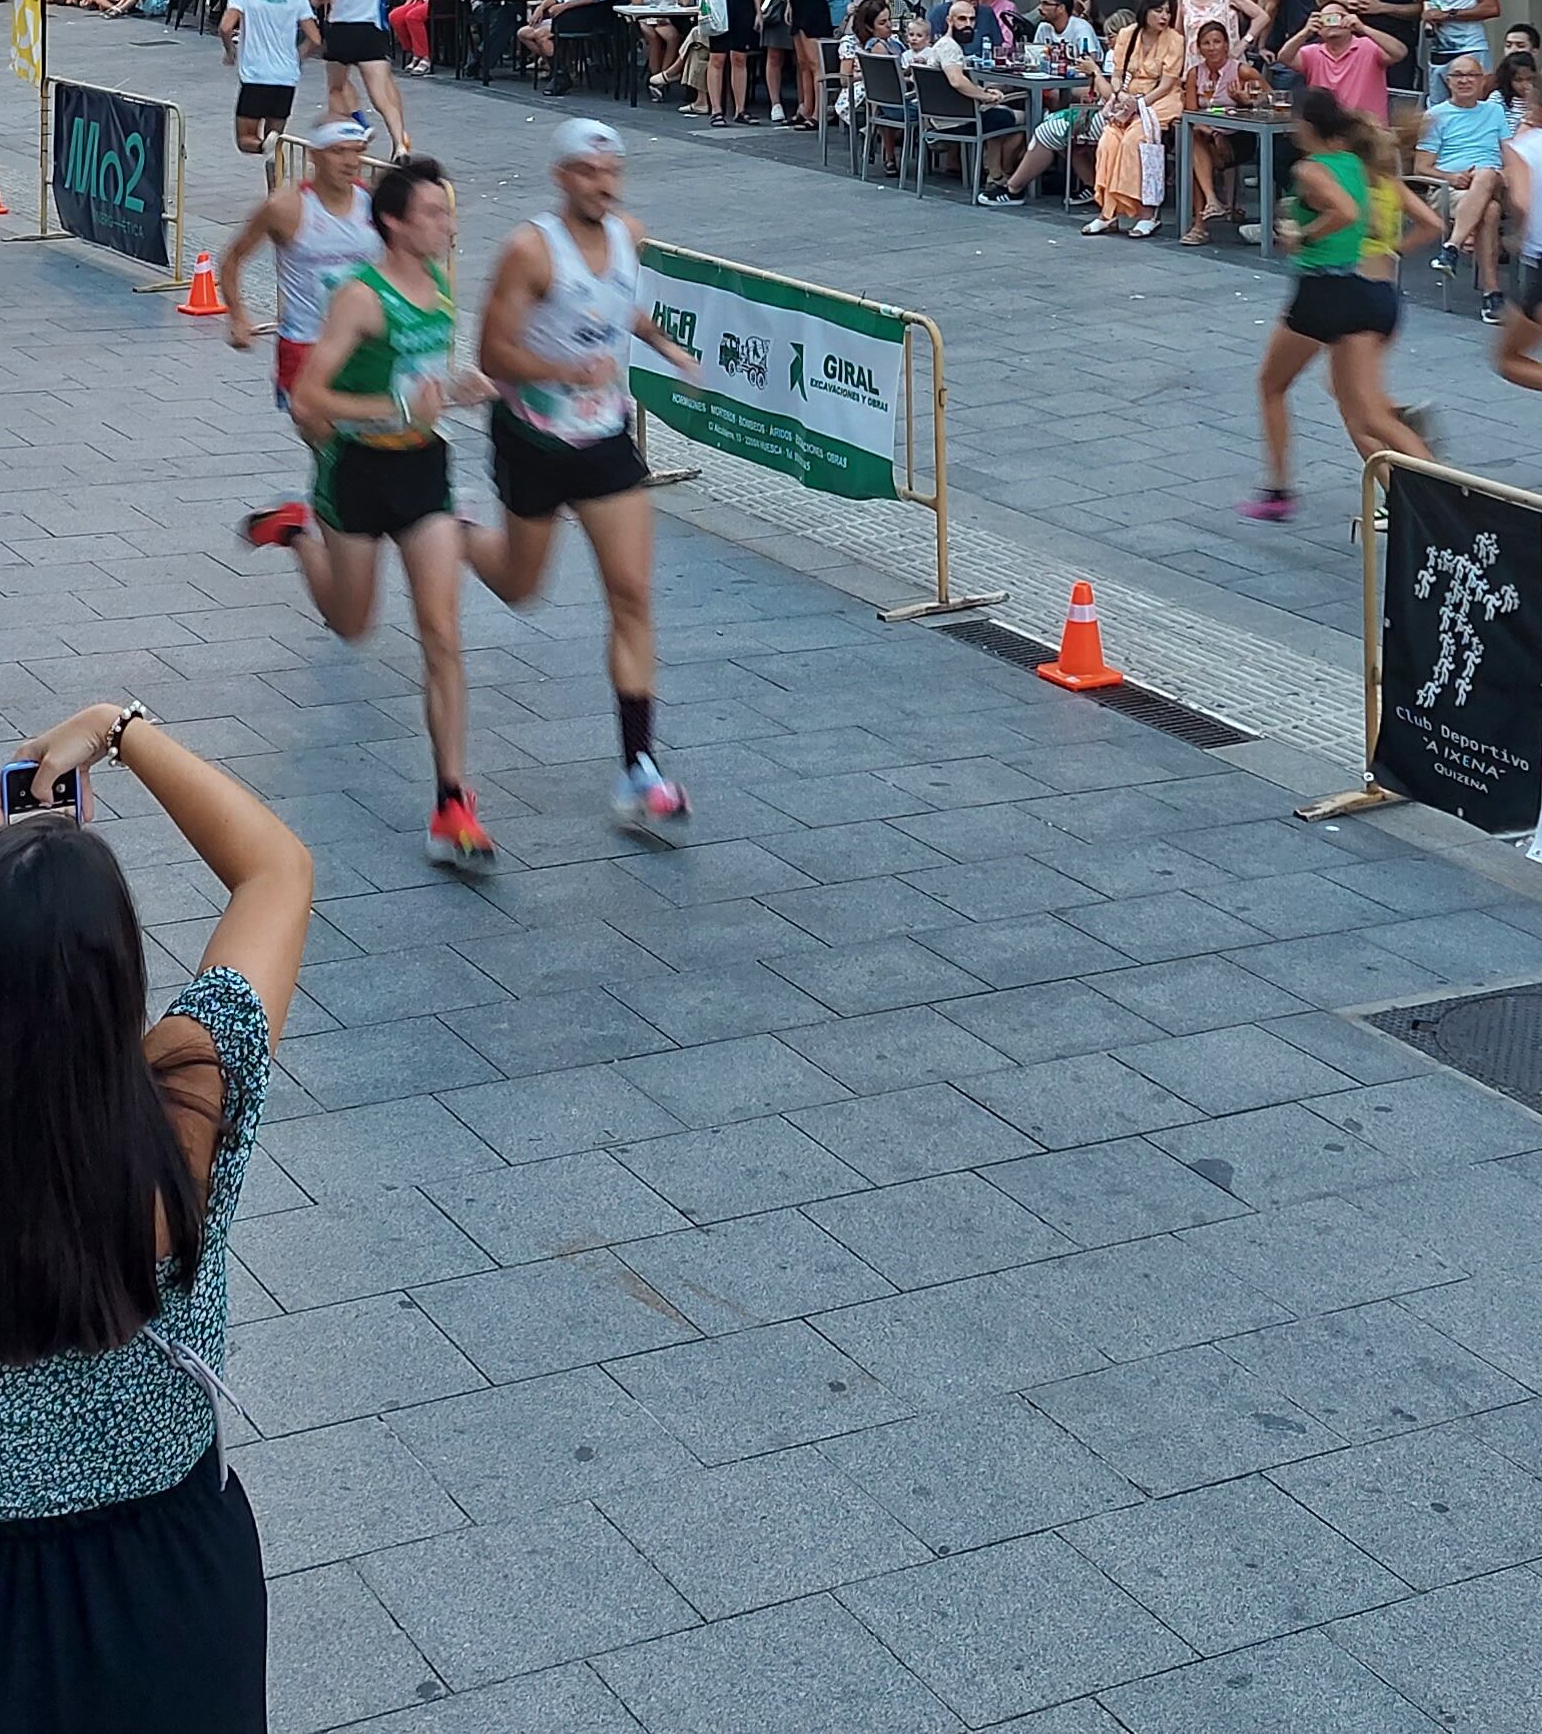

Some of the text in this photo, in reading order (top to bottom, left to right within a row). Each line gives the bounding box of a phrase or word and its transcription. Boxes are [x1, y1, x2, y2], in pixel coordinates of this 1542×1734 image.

[823, 354, 880, 396] GIRAL
[810, 377, 888, 413] EXCAVACIONES Y OBRAS
[826, 452, 847, 468] OBRAS
[1395, 706, 1530, 772] Club Deportivo
[1433, 762, 1489, 794] QUIZENA
